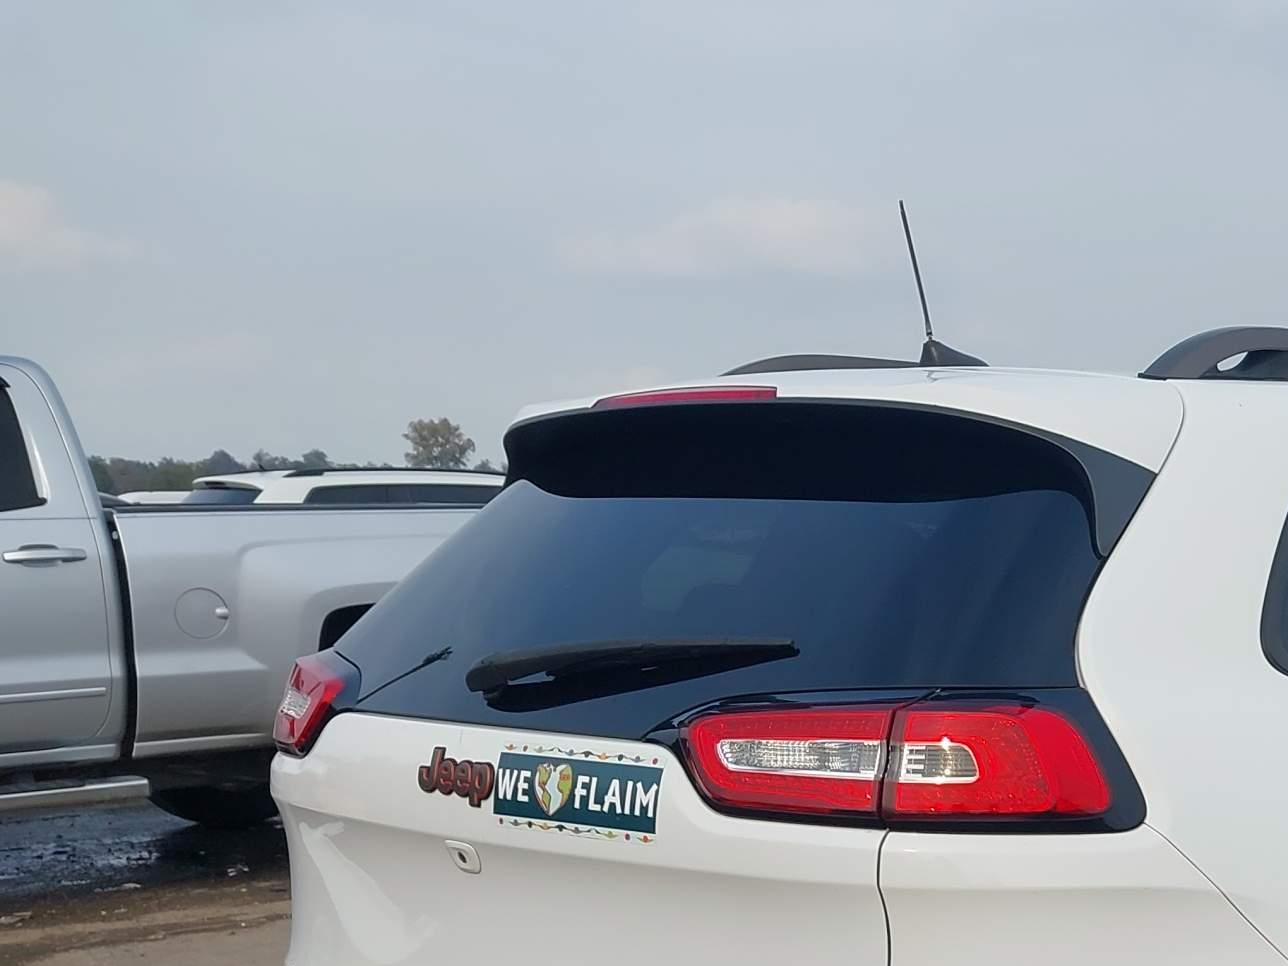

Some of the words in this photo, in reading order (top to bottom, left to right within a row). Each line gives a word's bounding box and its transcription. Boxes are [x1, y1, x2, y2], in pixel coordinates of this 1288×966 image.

[418, 746, 495, 808] Jeep
[498, 768, 531, 802] WE
[574, 775, 658, 818] FLAIM
